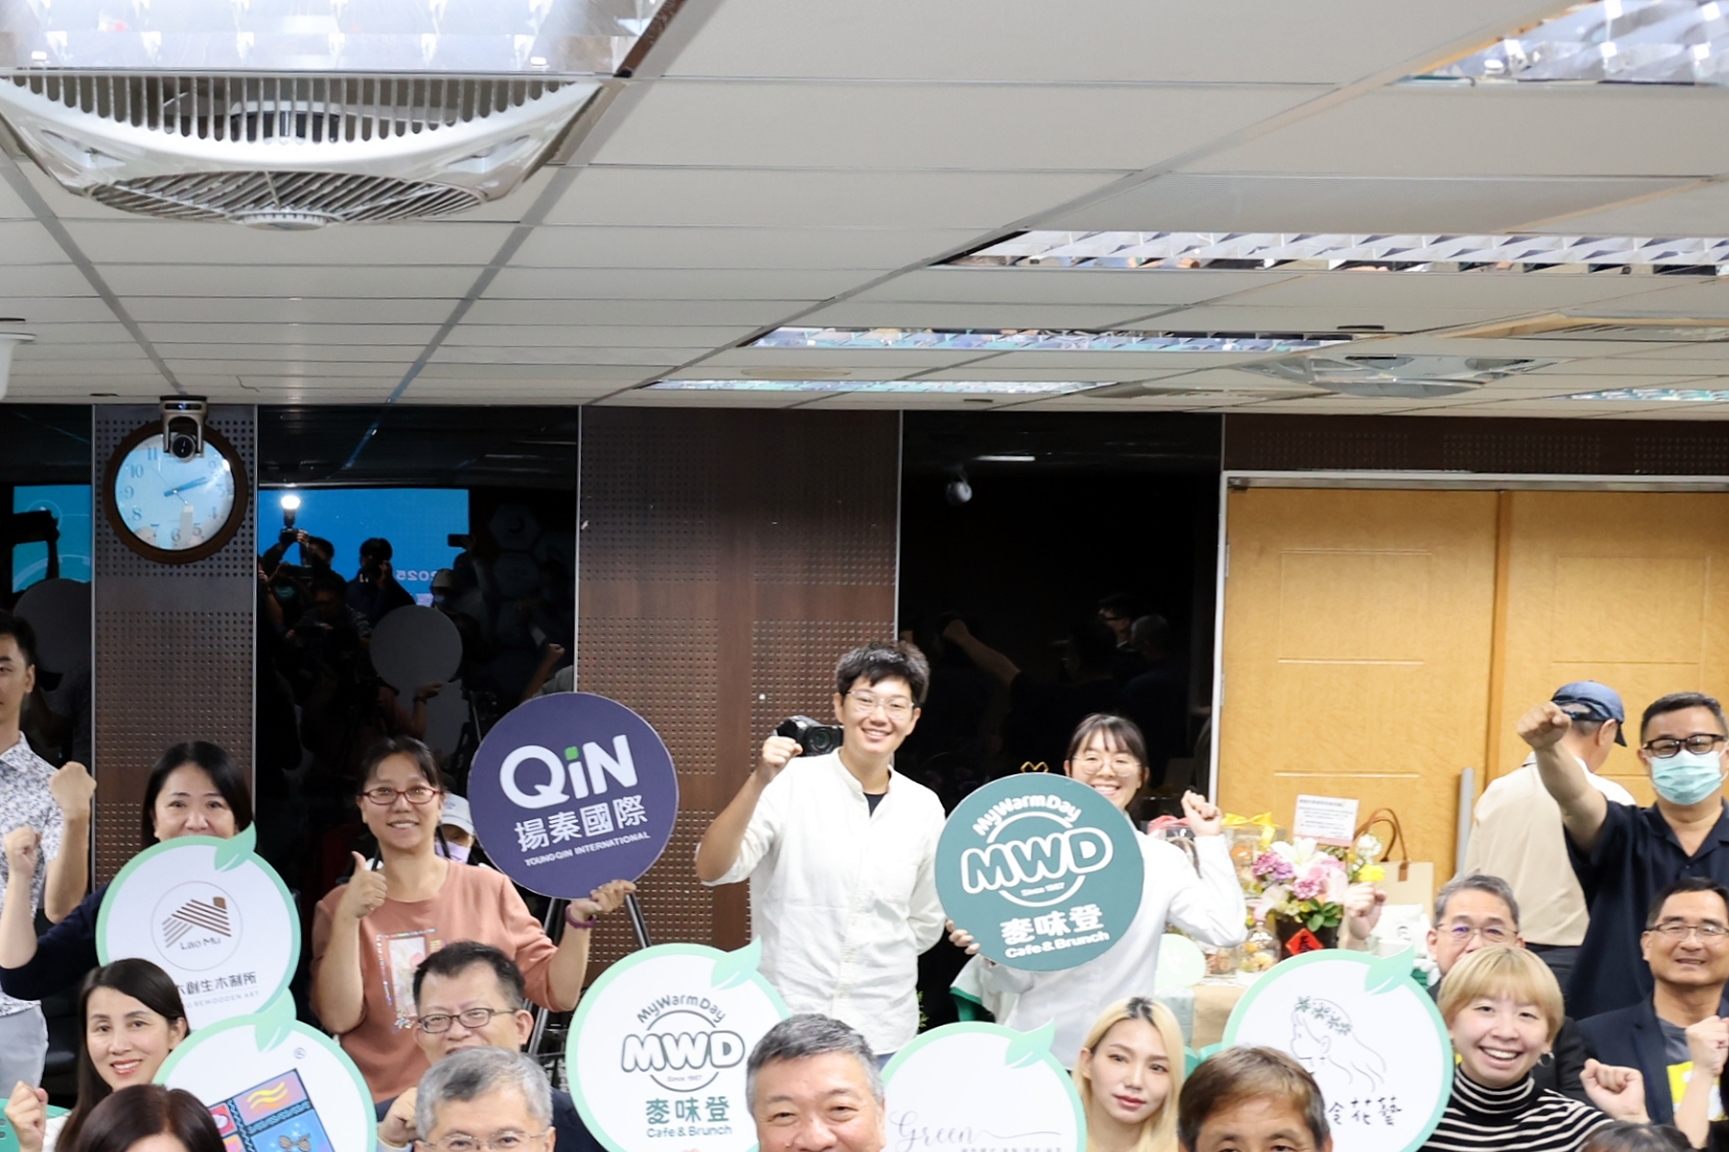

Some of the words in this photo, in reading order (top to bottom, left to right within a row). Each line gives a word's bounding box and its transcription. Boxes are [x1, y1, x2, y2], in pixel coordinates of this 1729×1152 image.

[148, 447, 158, 460] 11
[131, 464, 144, 478] 10
[124, 486, 134, 499] 9
[132, 508, 142, 521] 8
[171, 527, 181, 542] 6
[192, 522, 202, 537] 5
[514, 794, 648, 853] 揚秦國際
[972, 794, 1083, 837] MyWarmDay
[574, 831, 652, 856] INTERNATIONAL
[960, 827, 1114, 895] MWD
[999, 903, 1104, 946] 麥味登
[636, 994, 727, 1024] MyWarmDay
[621, 1030, 746, 1074] MWD
[645, 1096, 730, 1125] 麥味登
[647, 1127, 676, 1139] Cafe
[688, 1124, 733, 1137] Brunch
